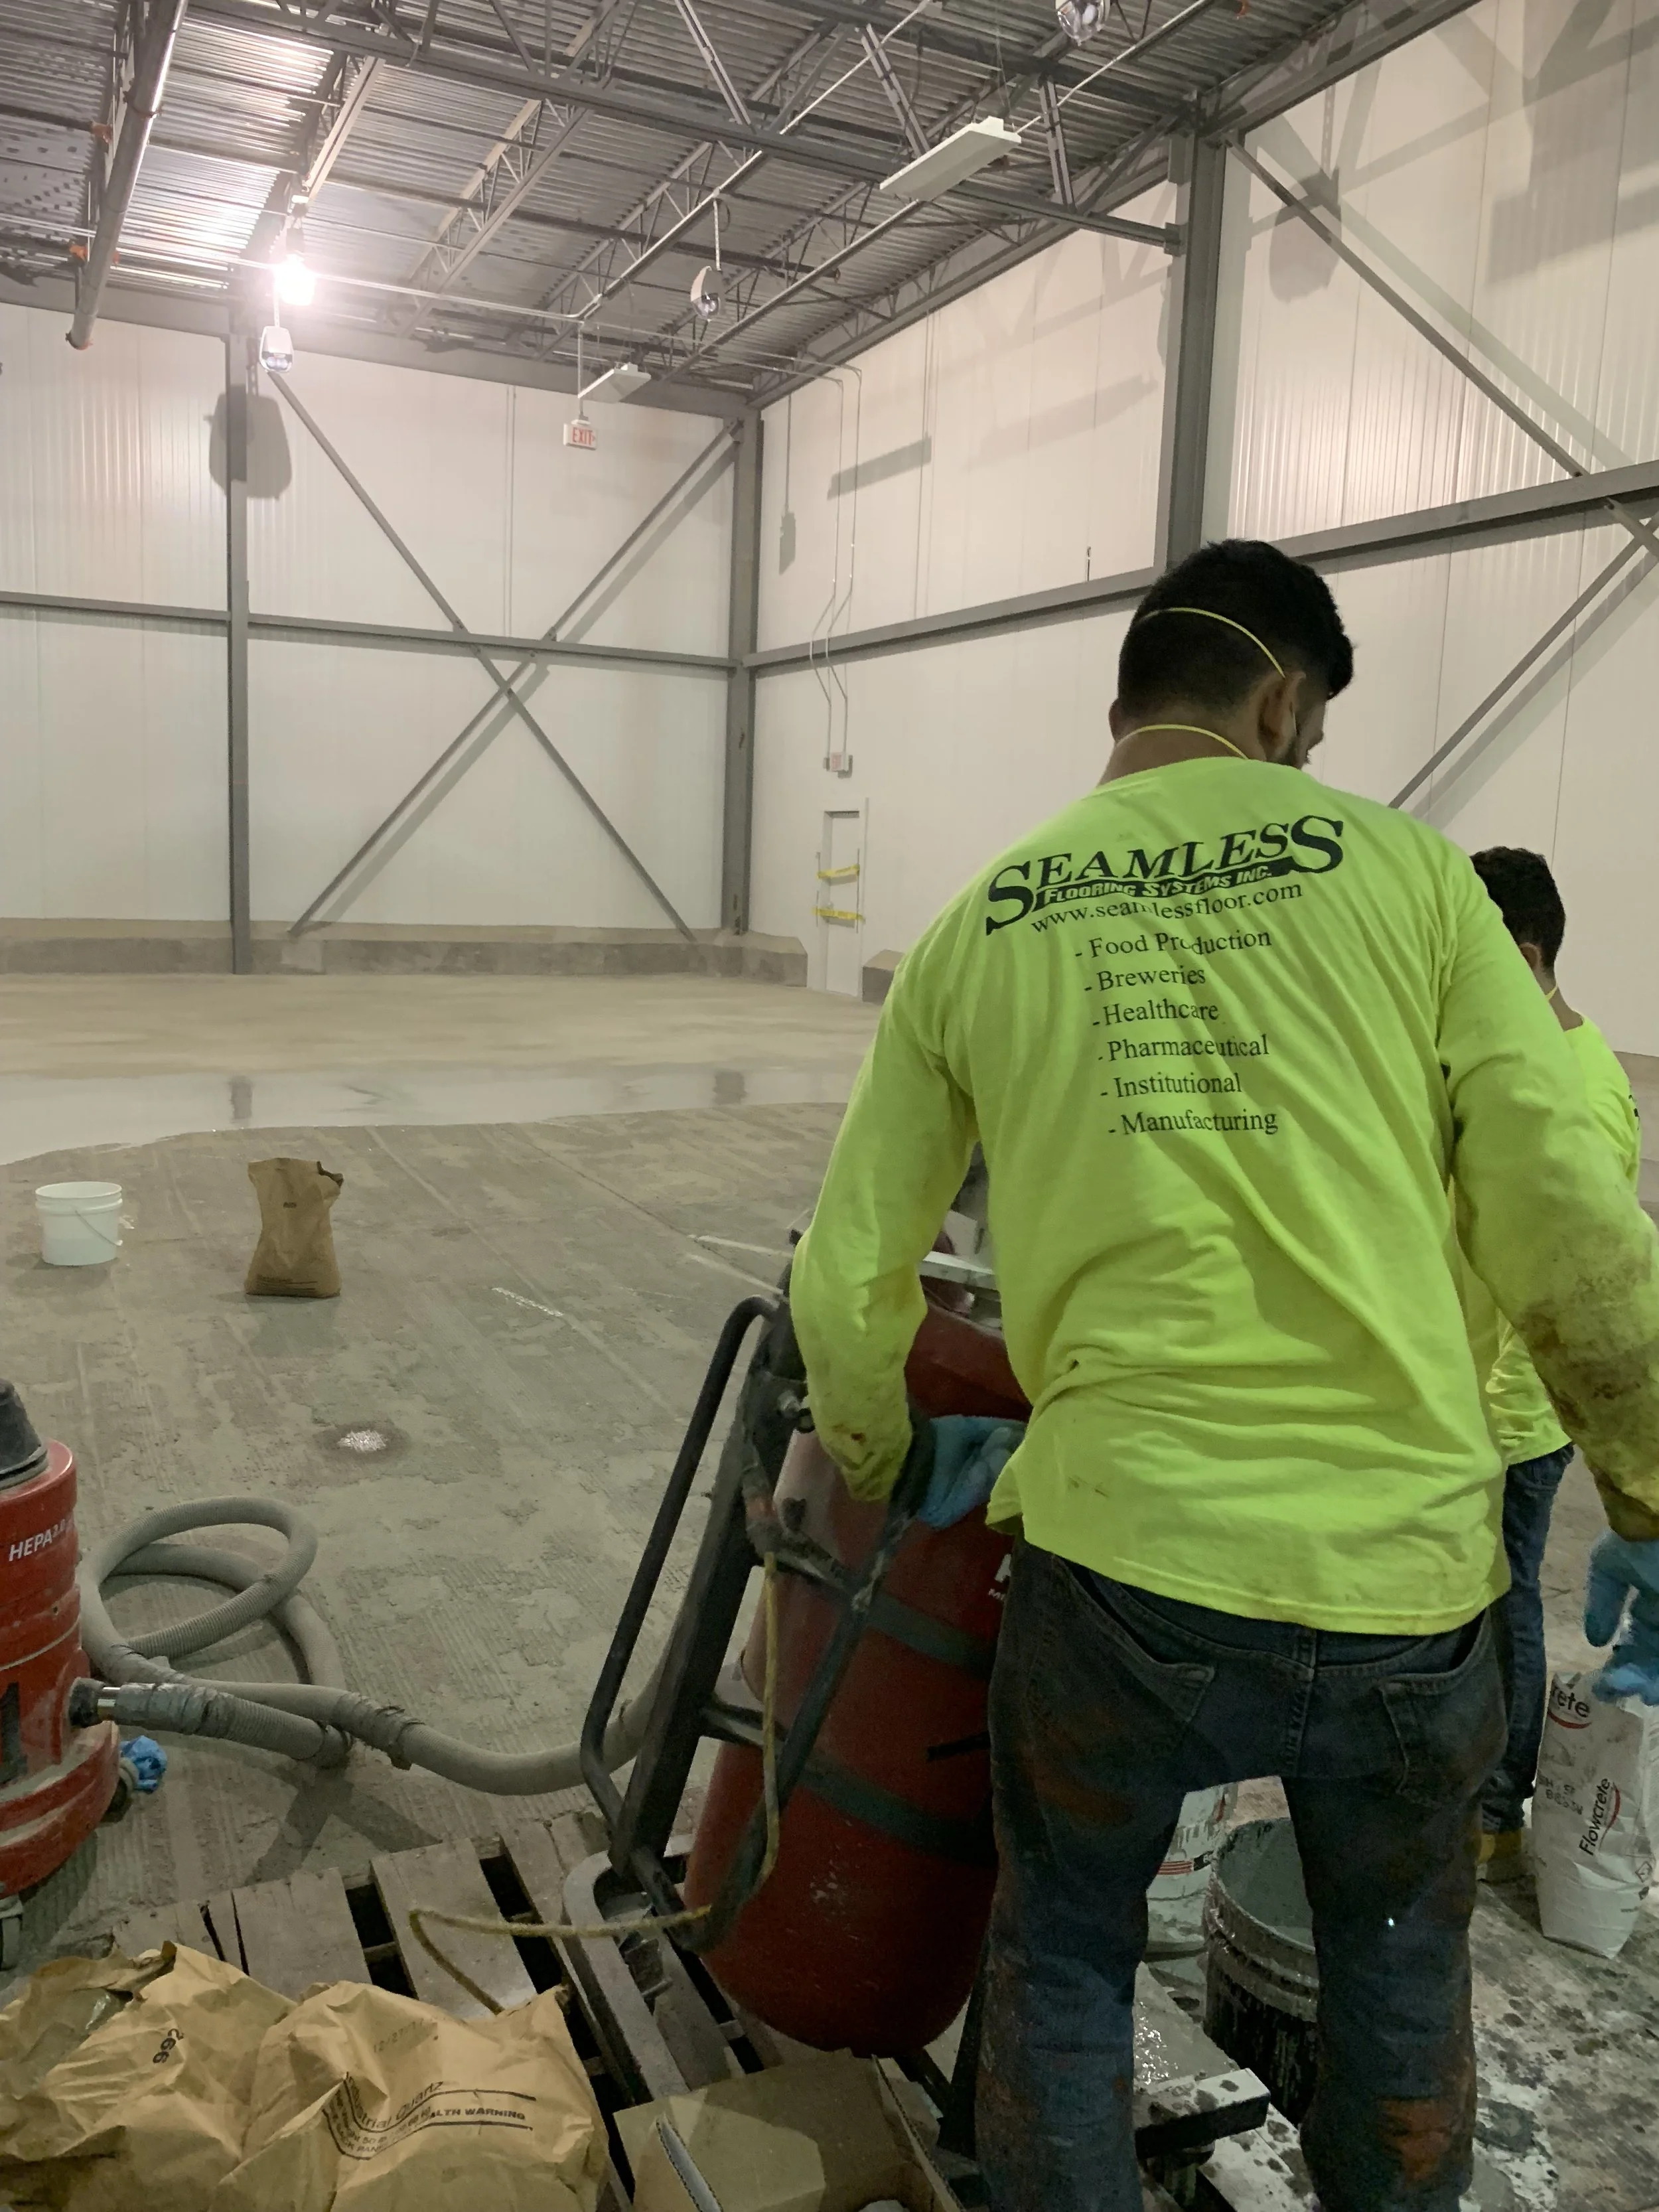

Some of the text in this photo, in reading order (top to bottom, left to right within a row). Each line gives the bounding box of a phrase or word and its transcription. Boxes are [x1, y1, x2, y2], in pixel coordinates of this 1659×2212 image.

[573, 427, 593, 445] EXIT
[985, 815, 1344, 935] SEAMLESS
[1043, 865, 1273, 904] FLOORING SYSTEMS INC.
[1031, 884, 1303, 933] www.seamlessfloor.com
[1088, 934, 1149, 958] Food
[1155, 929, 1272, 956] Production
[1096, 965, 1206, 992] Breweries
[1102, 998, 1220, 1026] Healthcare
[1107, 1033, 1270, 1062] Pharmaceutical
[1114, 1072, 1243, 1098] Institutional
[1121, 1108, 1279, 1136] Manufacturing
[9, 1528, 53, 1562] HEPA
[1579, 1778, 1611, 1856] Flowcrete
[465, 2107, 526, 2120] WARNING
